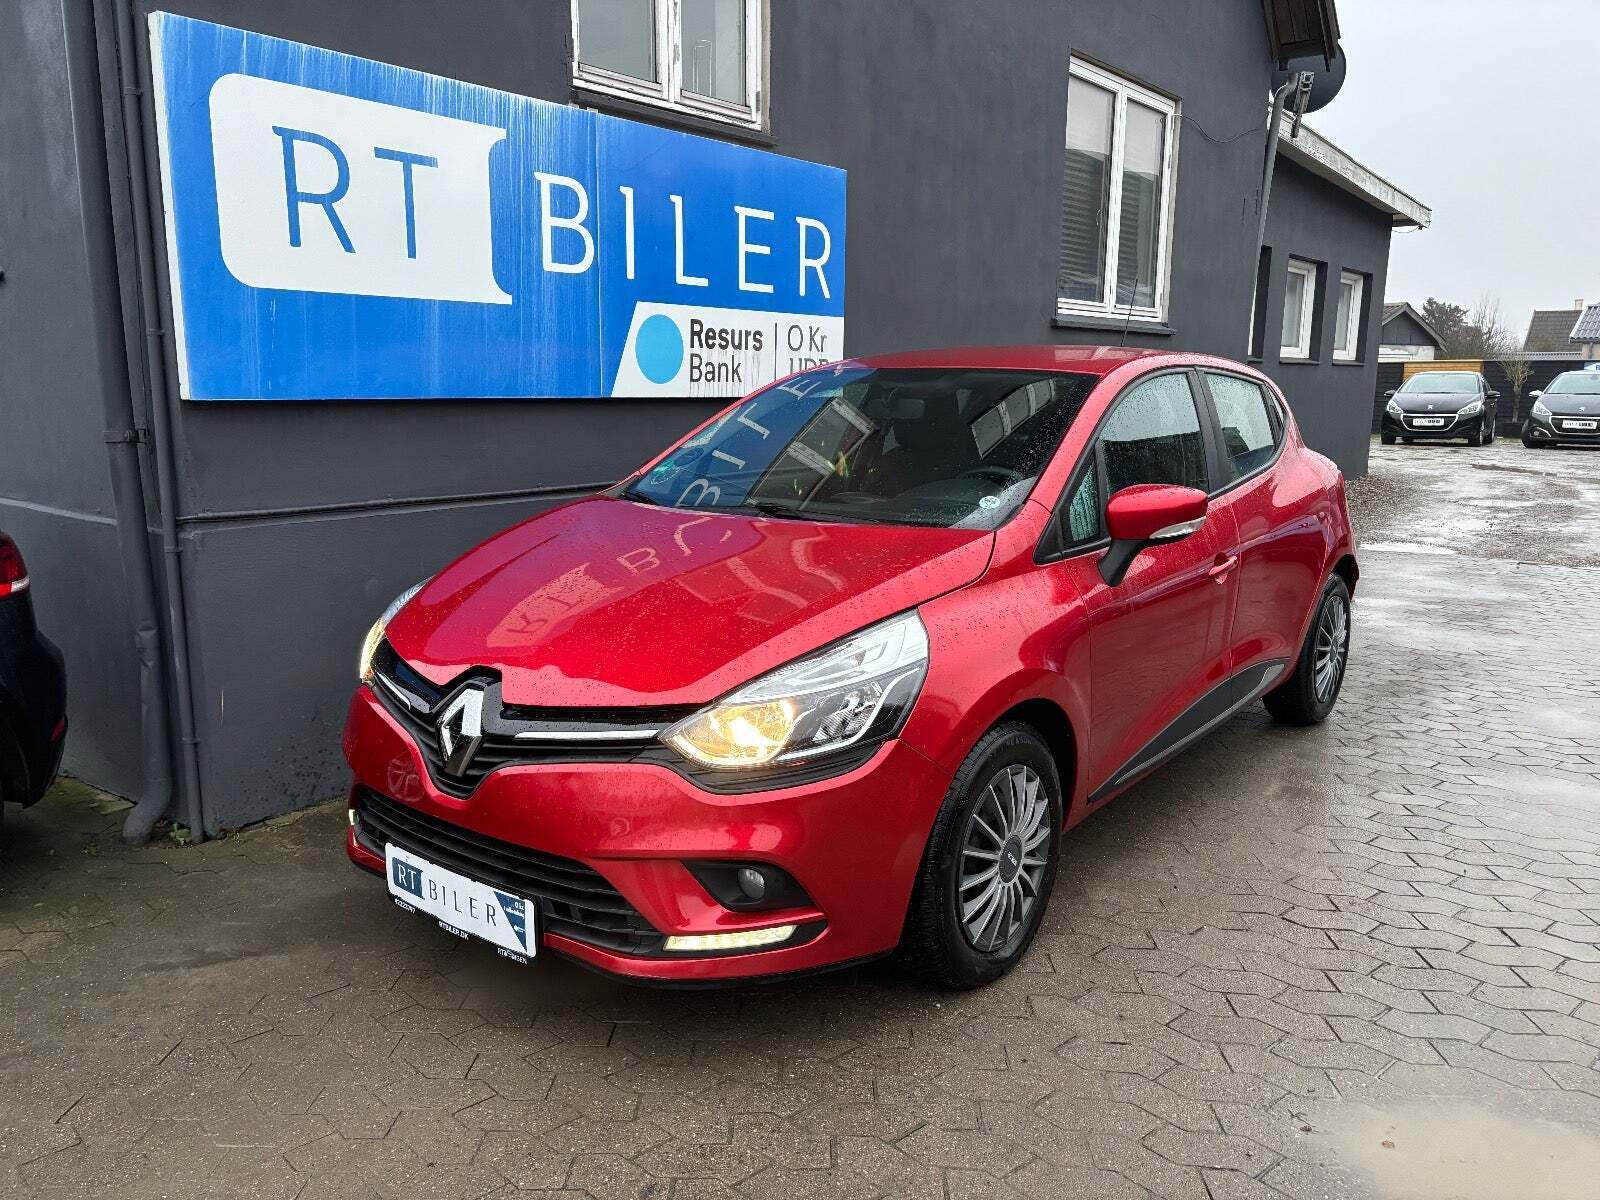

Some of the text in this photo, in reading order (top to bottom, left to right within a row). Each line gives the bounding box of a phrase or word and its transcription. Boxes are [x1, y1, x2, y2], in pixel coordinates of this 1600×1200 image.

[272, 126, 832, 299] RT BILER
[689, 319, 763, 351] Resurs
[808, 326, 828, 353] Kr
[689, 353, 742, 383] Bank
[398, 863, 417, 891] RT
[428, 879, 497, 927] BILER
